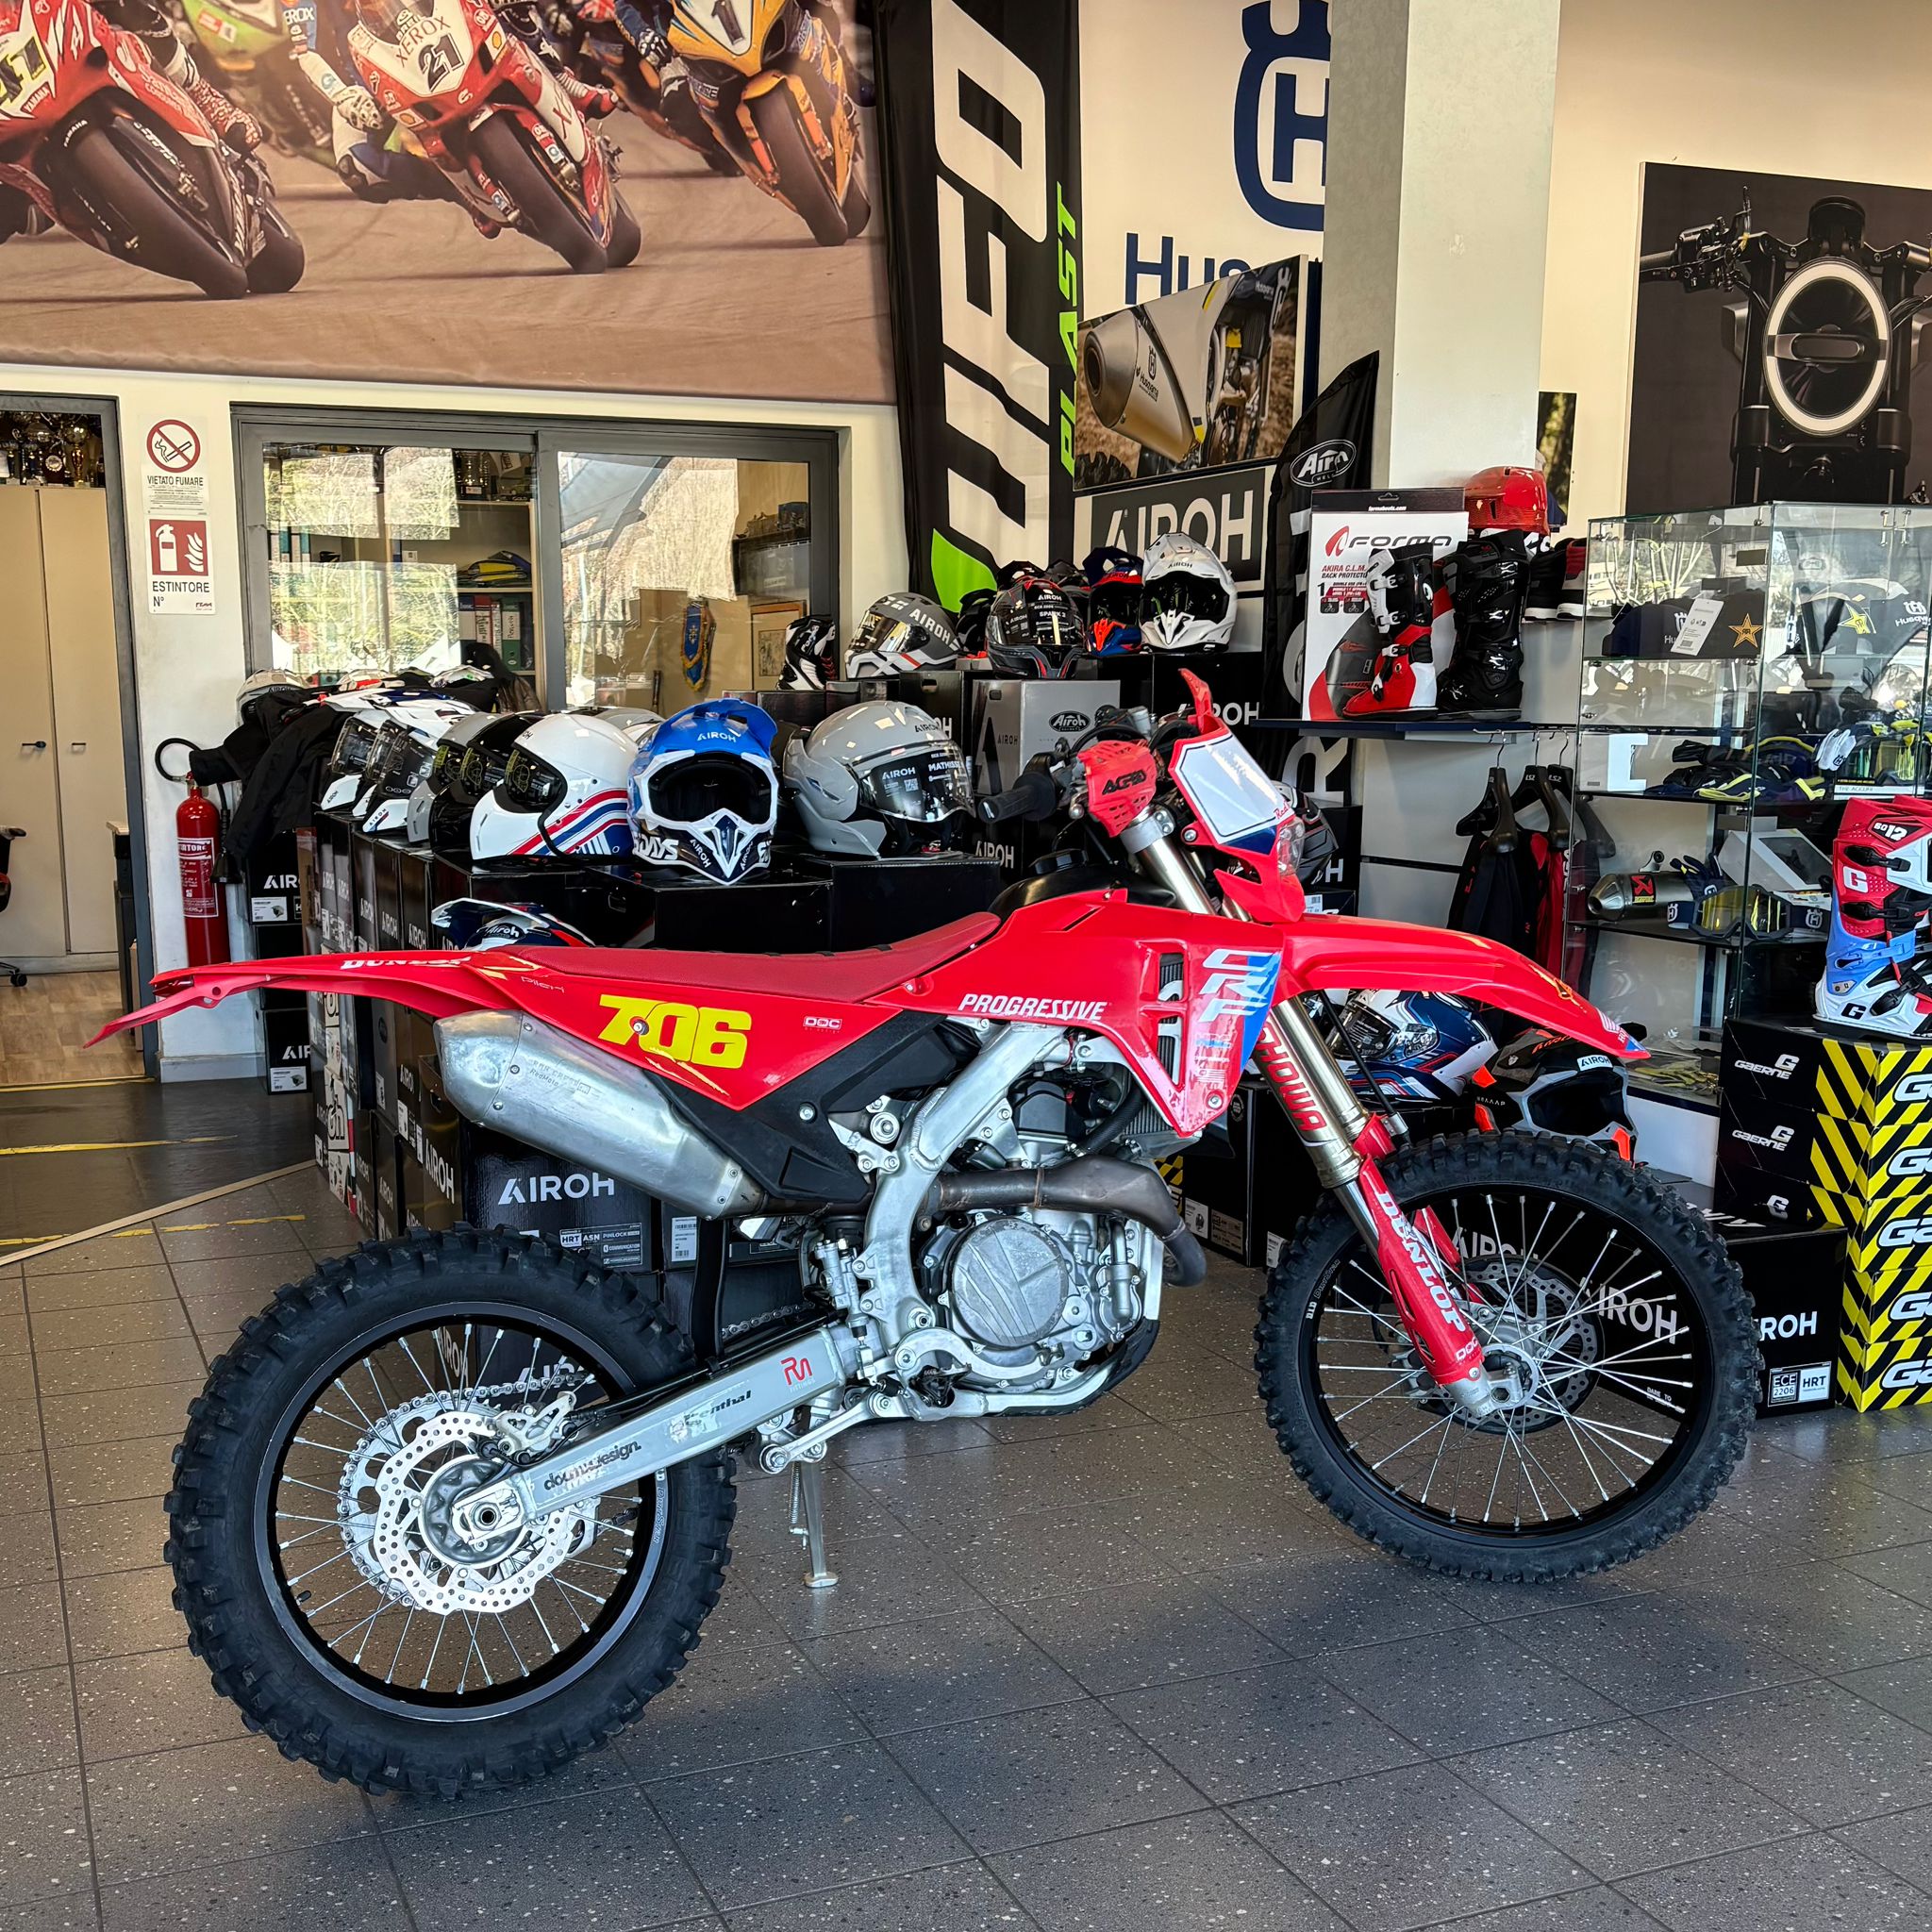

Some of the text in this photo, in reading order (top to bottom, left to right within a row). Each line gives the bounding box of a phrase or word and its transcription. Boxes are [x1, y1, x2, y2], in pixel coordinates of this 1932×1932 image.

[396, 16, 451, 67] XEROX
[418, 33, 464, 92] 21
[24, 83, 51, 113] YAMAHA
[63, 120, 89, 147] YAMAHA
[147, 475, 204, 486] VIETATO FUMARE
[152, 581, 209, 592] ESTINTORE
[909, 608, 951, 645] AIROH
[1050, 713, 1088, 727] Airoh
[696, 732, 737, 743] AIROH
[997, 735, 1019, 744] AIROH
[882, 767, 916, 780] AIROH
[369, 808, 387, 826] AIROH
[690, 839, 711, 868] AIROH
[264, 874, 300, 890] AIR
[486, 924, 520, 937] Airoh
[957, 993, 1108, 1022] PROGRESSIVE
[597, 994, 752, 1069] 706
[282, 1045, 311, 1059] AIR
[1580, 1056, 1610, 1068] AIROH
[1256, 1021, 1327, 1131] SHOWA
[425, 1138, 455, 1205] AIROH
[498, 1173, 615, 1206] AIROH
[1376, 1191, 1466, 1332] DUNLOP
[1306, 1302, 1317, 1320] DID
[1580, 1277, 1677, 1345] IROH
[1757, 1310, 1818, 1341] ROH
[1774, 1374, 1826, 1388] ECE HRT
[1774, 1387, 1794, 1396] 2206
